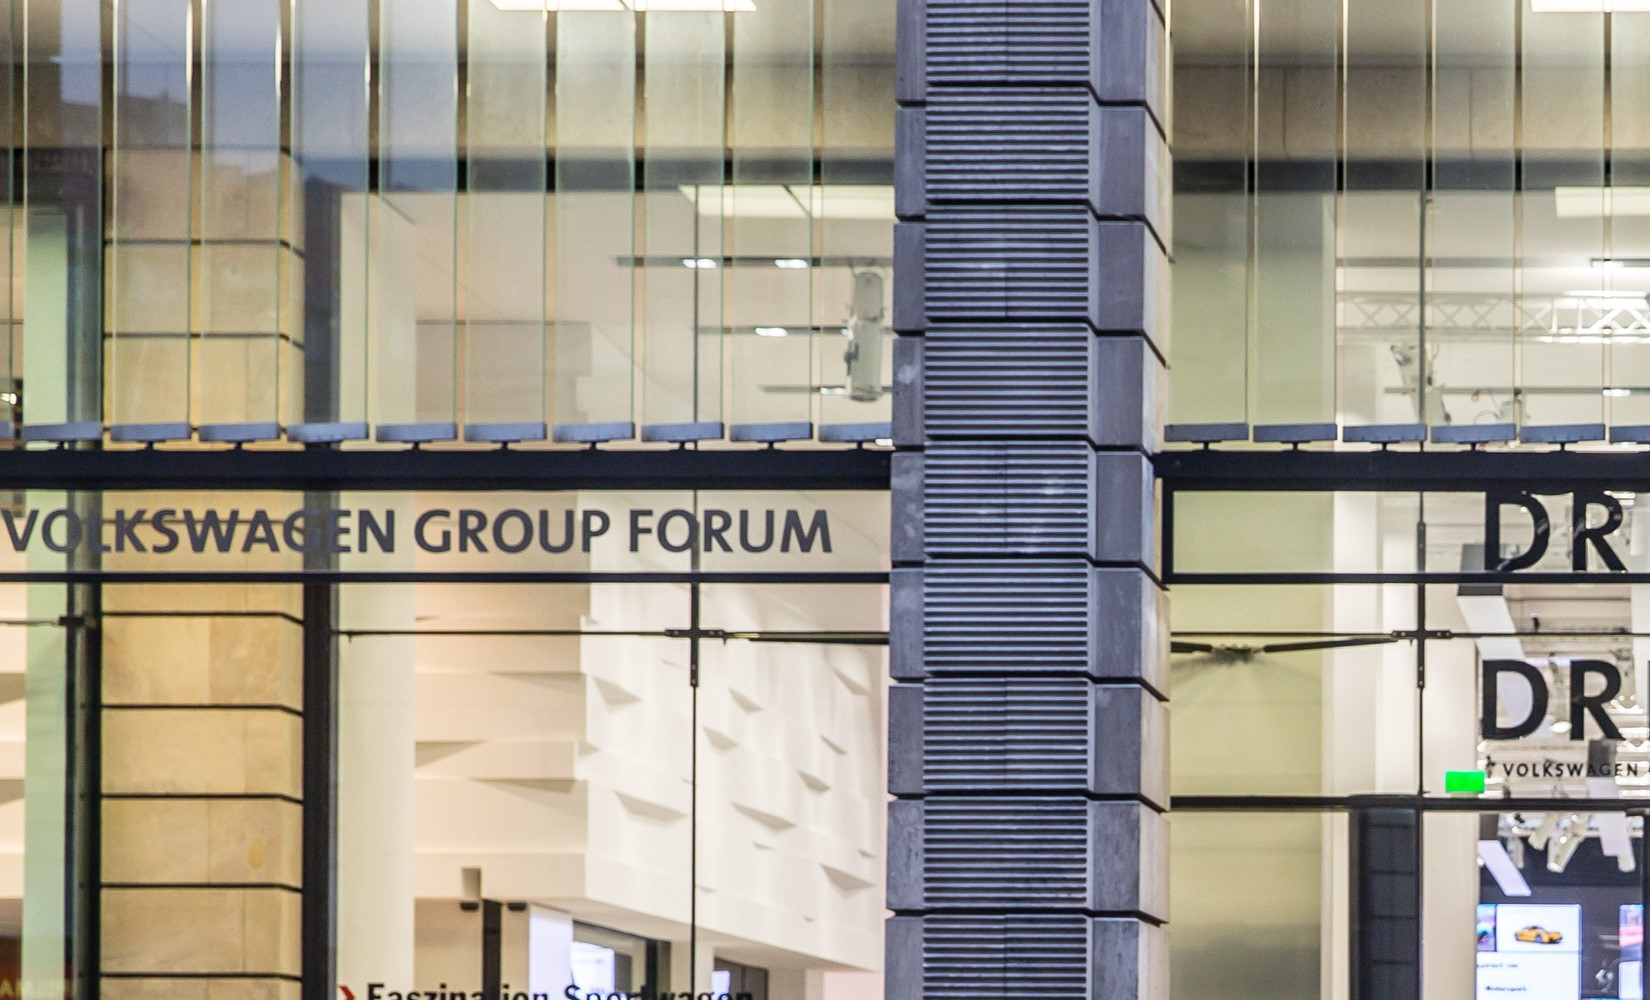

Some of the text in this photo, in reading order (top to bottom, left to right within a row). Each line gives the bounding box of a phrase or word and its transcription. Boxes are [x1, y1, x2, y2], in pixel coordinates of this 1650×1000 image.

[1, 508, 834, 553] VOLKSWAGEN GROUP FORUM
[1502, 763, 1638, 778] VOLKSWAGEN
